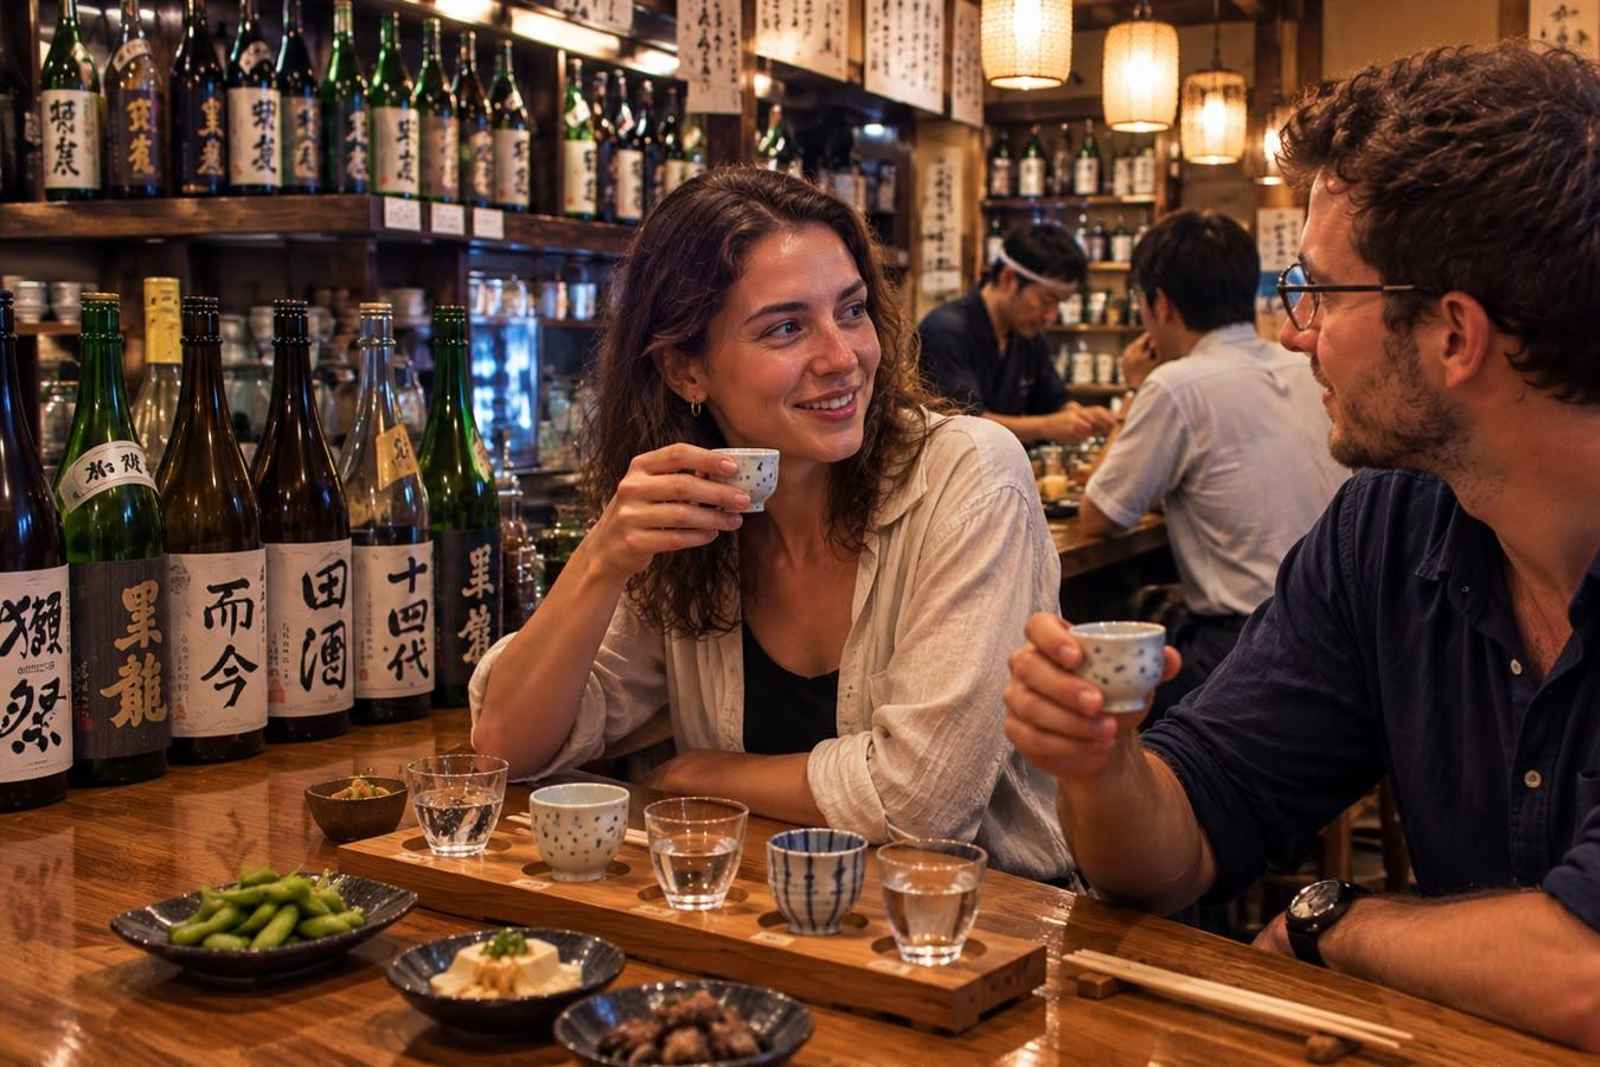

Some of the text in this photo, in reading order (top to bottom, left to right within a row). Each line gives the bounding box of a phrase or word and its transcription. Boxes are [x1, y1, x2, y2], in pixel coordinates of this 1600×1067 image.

[200, 577, 259, 709] 而今
[301, 558, 348, 692] 田酒
[387, 556, 430, 682] 十四代
